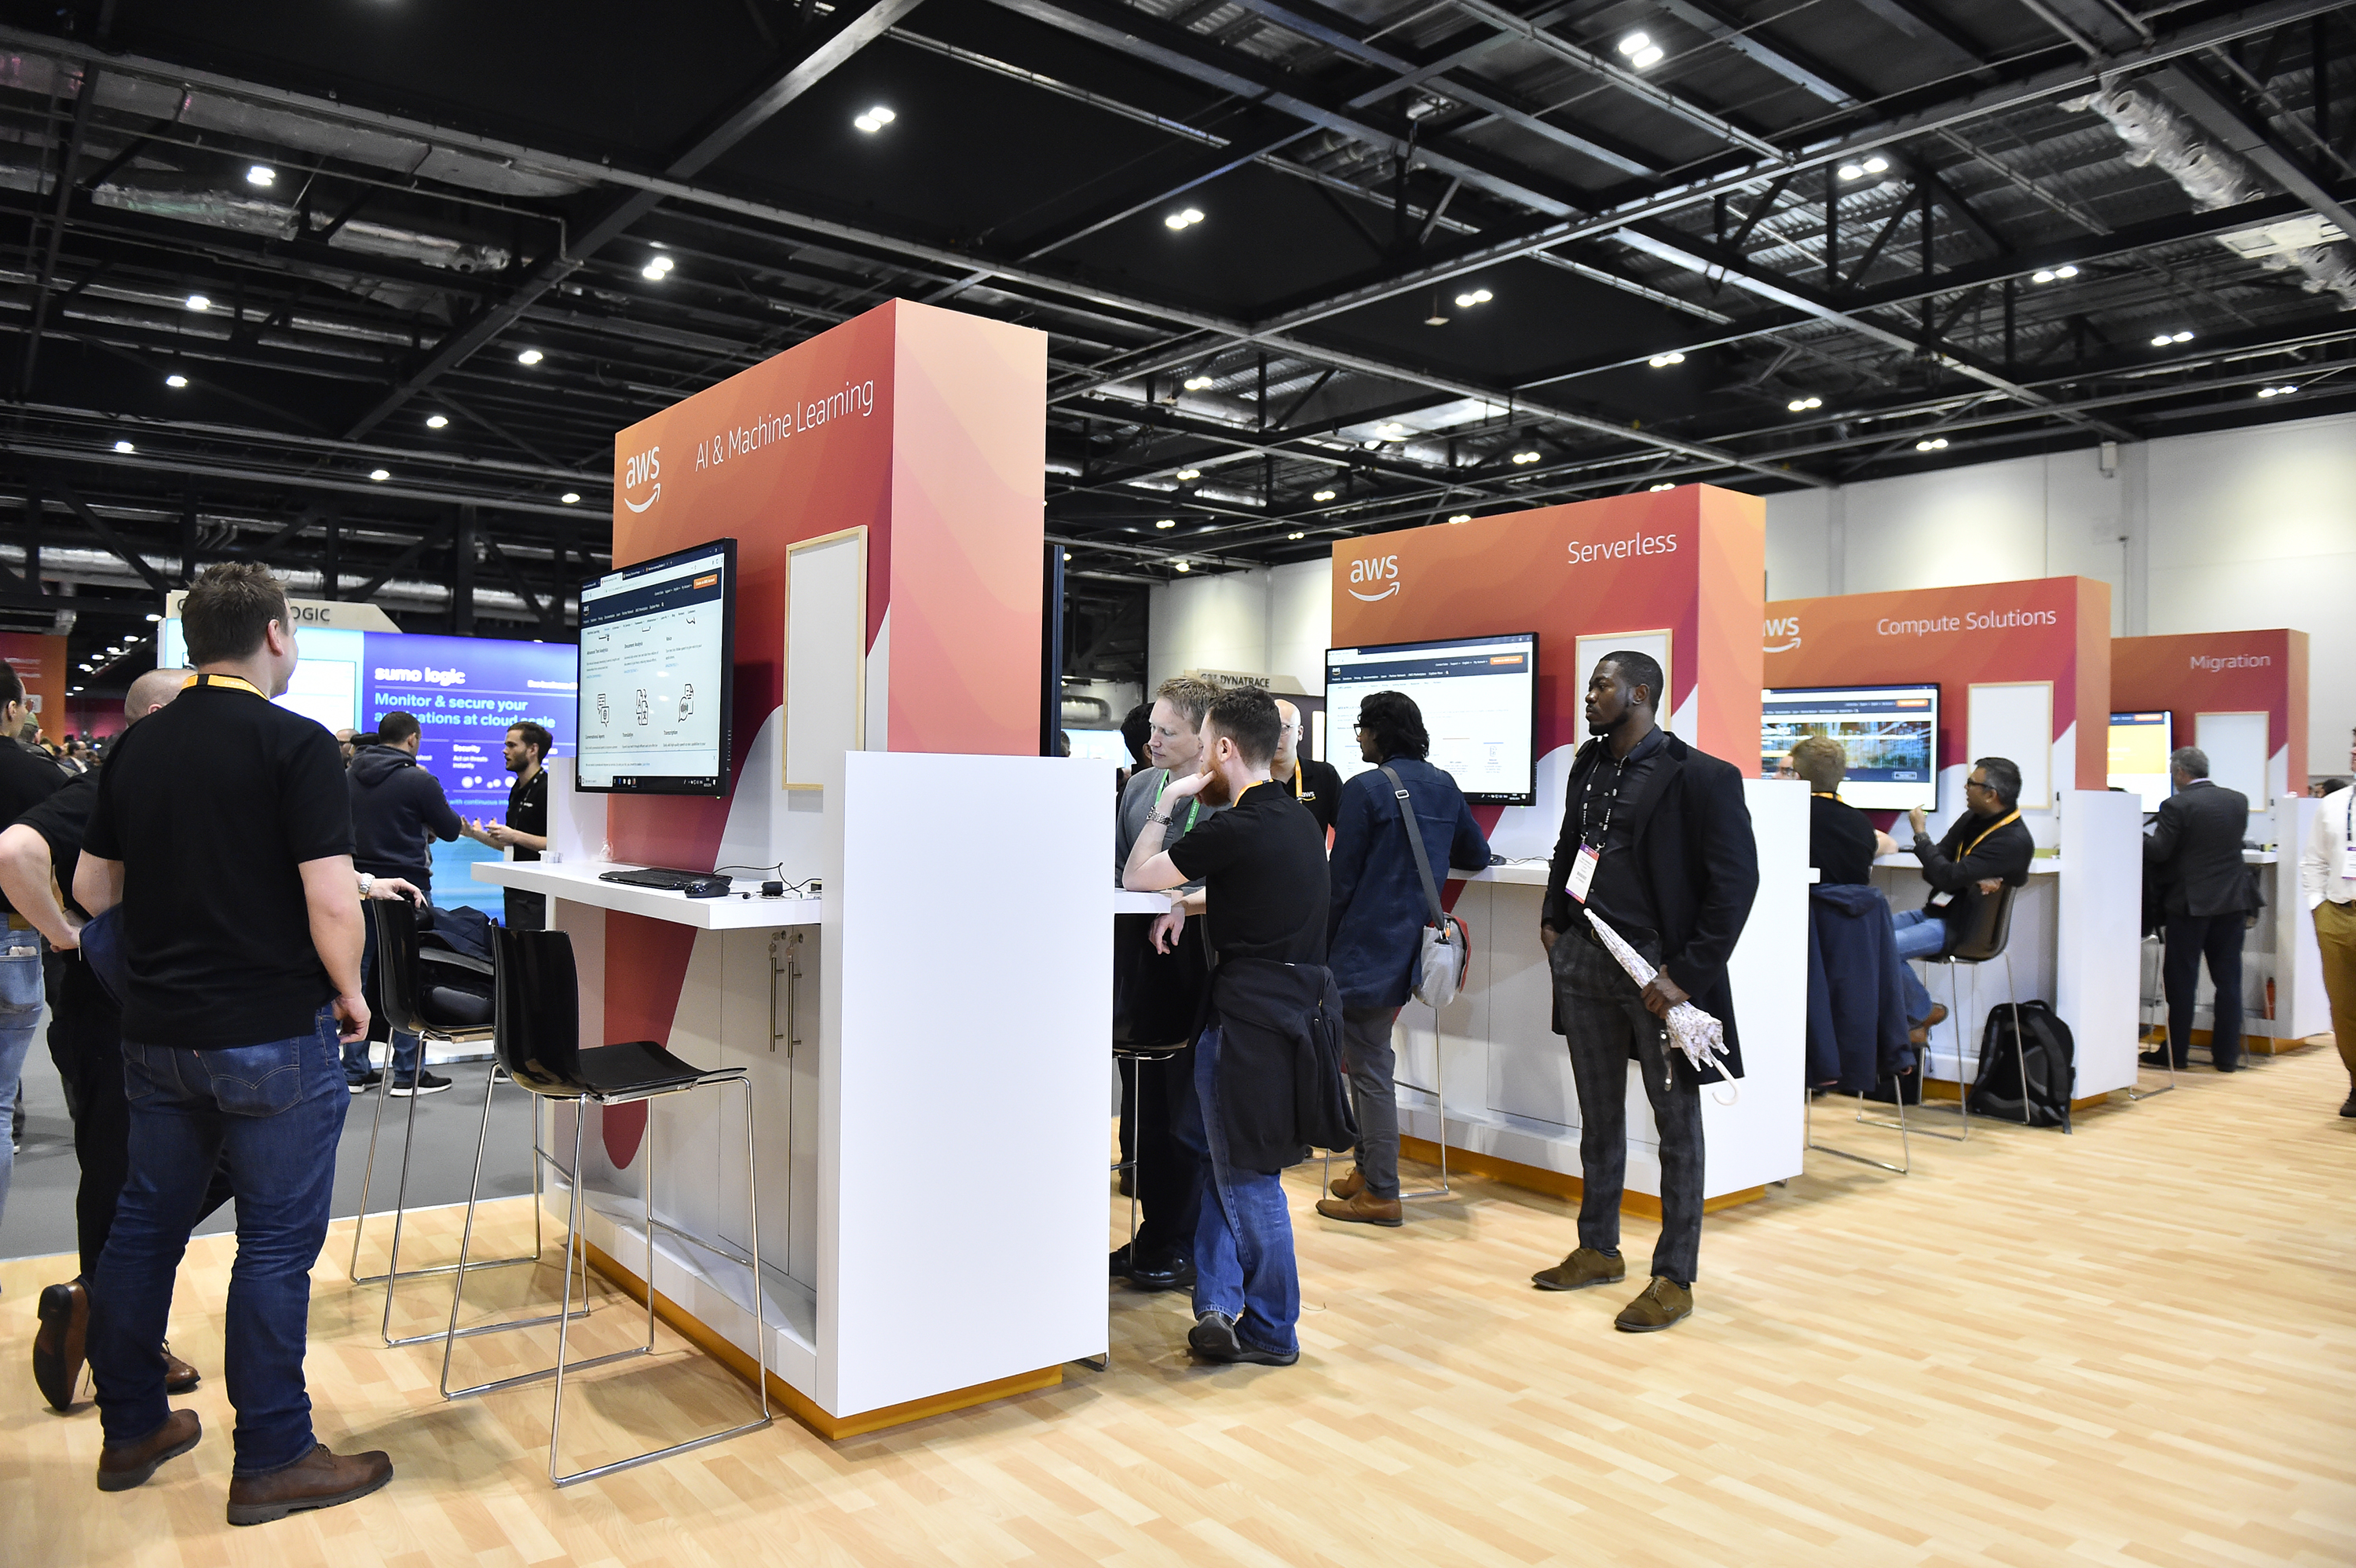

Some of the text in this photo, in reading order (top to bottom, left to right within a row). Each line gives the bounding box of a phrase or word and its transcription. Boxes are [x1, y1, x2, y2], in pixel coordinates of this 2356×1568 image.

[695, 378, 874, 472] AI & Machine Learning
[625, 446, 660, 489] aws
[1567, 532, 1677, 565] Serverless
[1350, 554, 1399, 584] aws
[289, 605, 331, 622] OGIC
[1876, 609, 2057, 637] Compute Solutions
[1762, 616, 1800, 637] ws
[2189, 653, 2272, 673] Migration
[375, 667, 466, 687] sumo logic
[1220, 674, 1271, 689] DYNATRACE
[375, 692, 529, 713] Monitor & secure your
[374, 710, 461, 725] aations
[463, 713, 478, 726] at
[480, 713, 518, 727] cloud
[452, 744, 481, 754] Security
